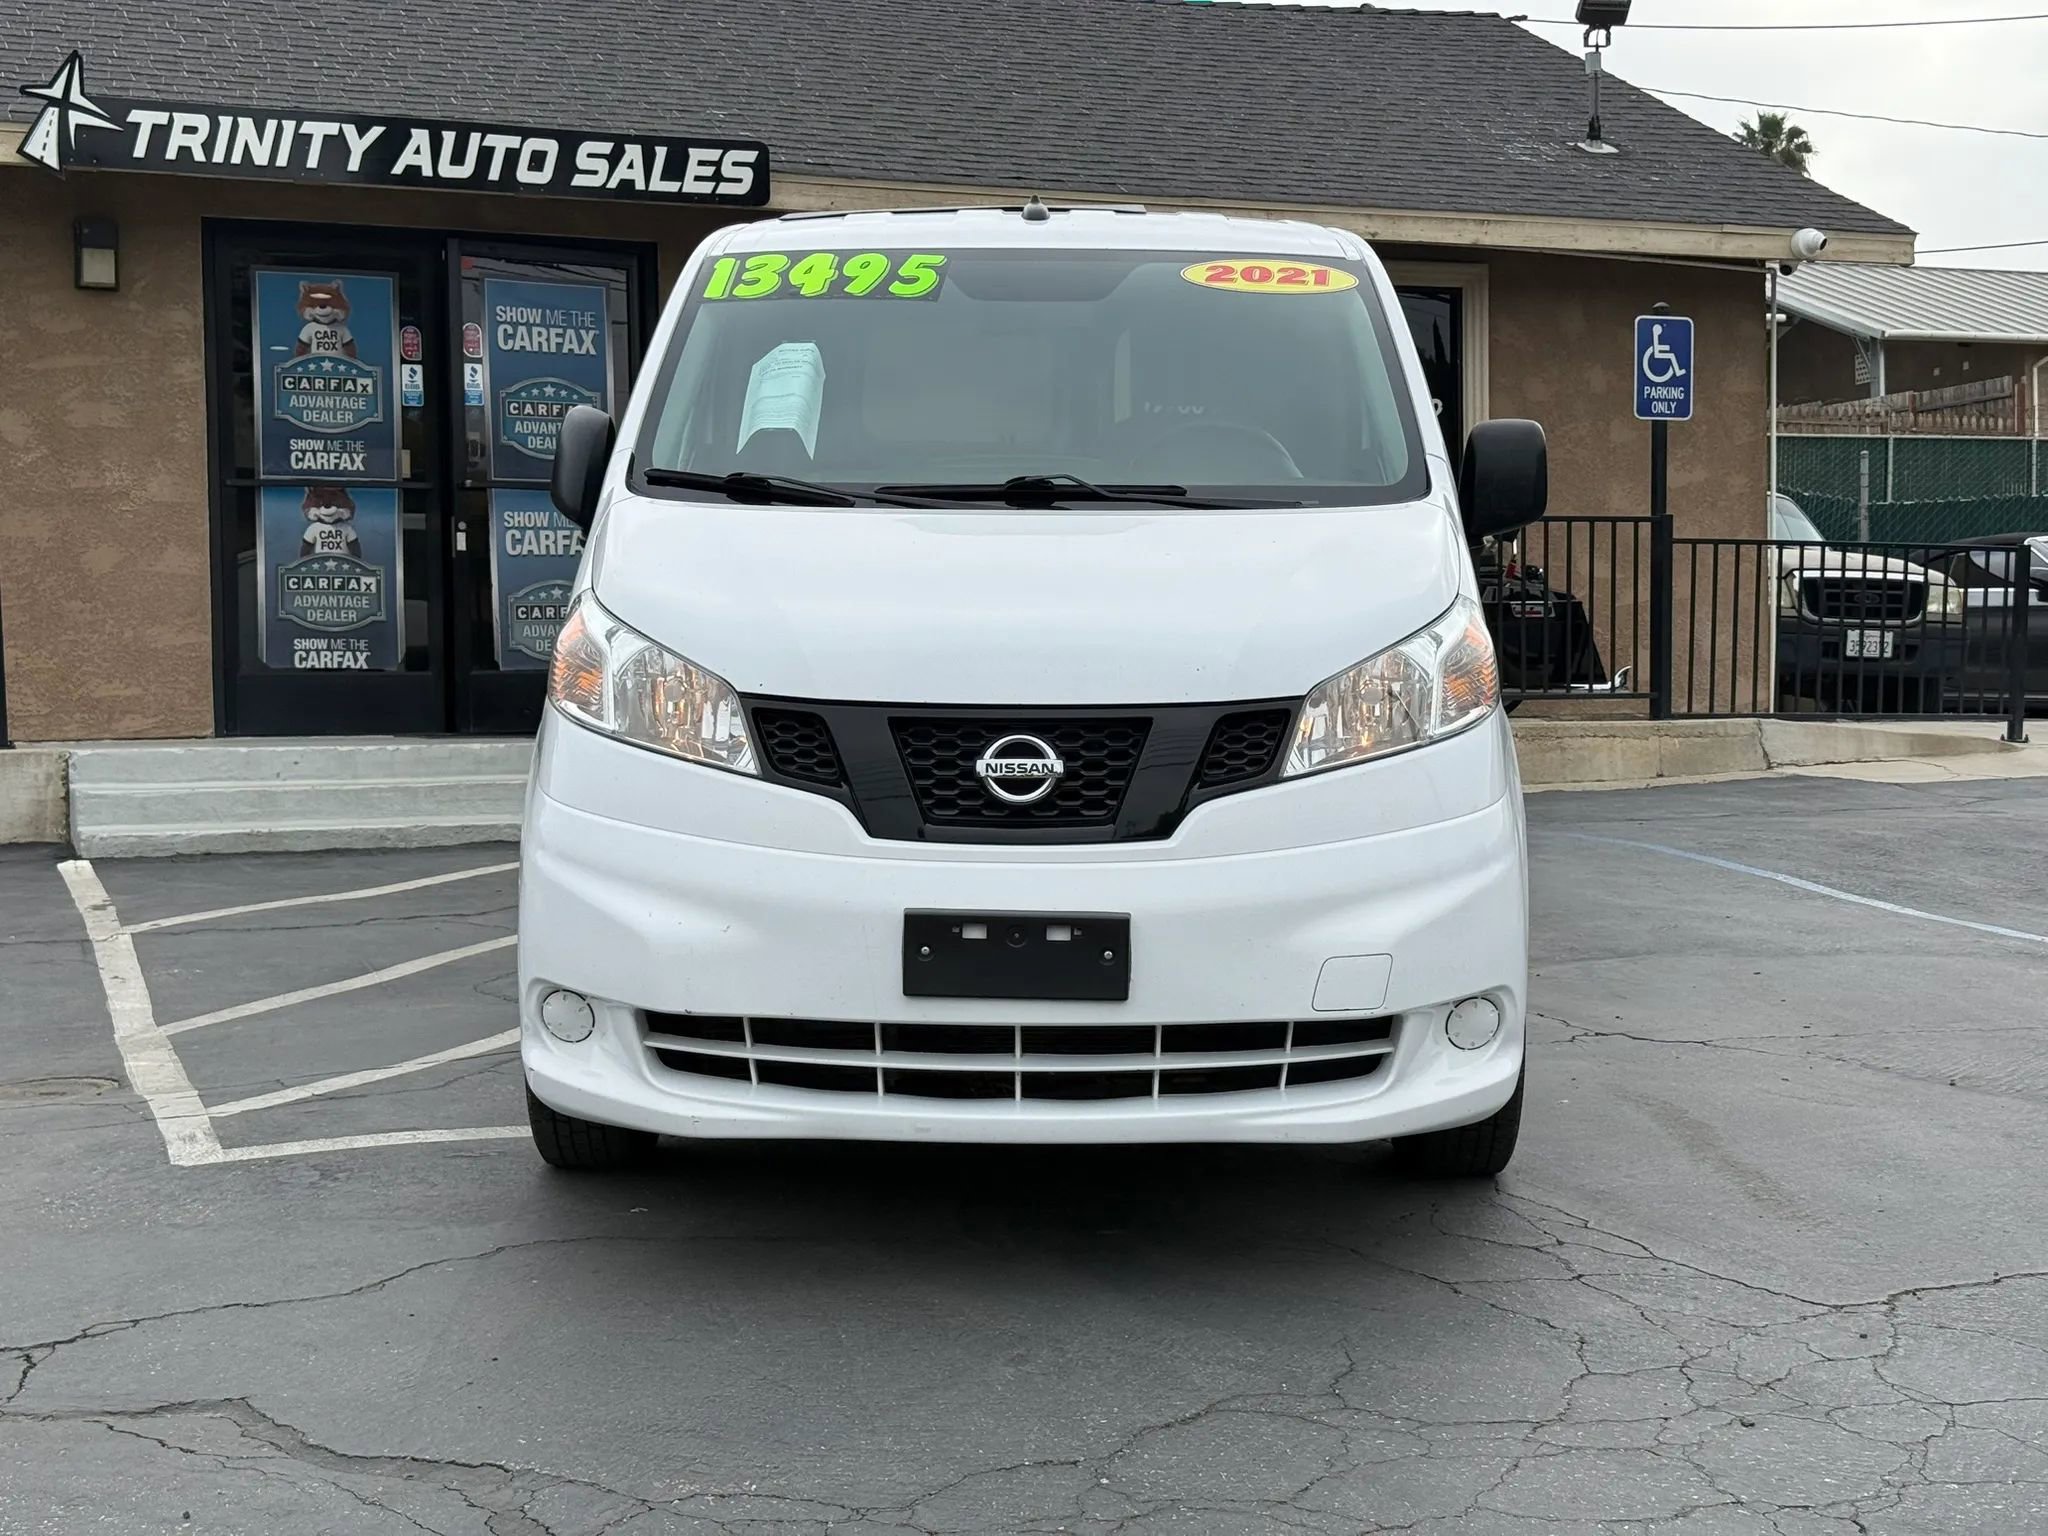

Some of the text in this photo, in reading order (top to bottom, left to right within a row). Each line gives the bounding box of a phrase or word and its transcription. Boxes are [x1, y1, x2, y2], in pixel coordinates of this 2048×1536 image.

[126, 109, 759, 195] TRINITY AUTO SALES
[703, 252, 947, 299] 13495
[1204, 265, 1331, 287] 2021
[496, 305, 596, 328] SHOW ME THE
[314, 330, 338, 341] CAR
[497, 324, 597, 355] CARFAX
[316, 341, 338, 351] FOX
[284, 377, 370, 394] CARFAX
[1644, 386, 1685, 400] PARKING
[289, 394, 367, 410] ADVANTAGE
[1651, 401, 1677, 414] ONLY
[303, 410, 354, 424] DEALER
[509, 403, 574, 417] CARF
[290, 438, 365, 452] SHOW ME THE
[290, 451, 366, 471] CARFAX
[503, 511, 549, 528] SHOW
[319, 530, 343, 540] CAR
[320, 541, 343, 550] FOX
[505, 529, 584, 556] CARFA
[288, 578, 373, 592] CARFAX
[294, 595, 370, 608] ADVANTAGE
[307, 610, 357, 622] DEALER
[517, 606, 568, 619] CARF
[293, 638, 369, 651] SHOW ME THE
[294, 651, 369, 669] CARFAX
[985, 762, 1054, 774] NISSAN
